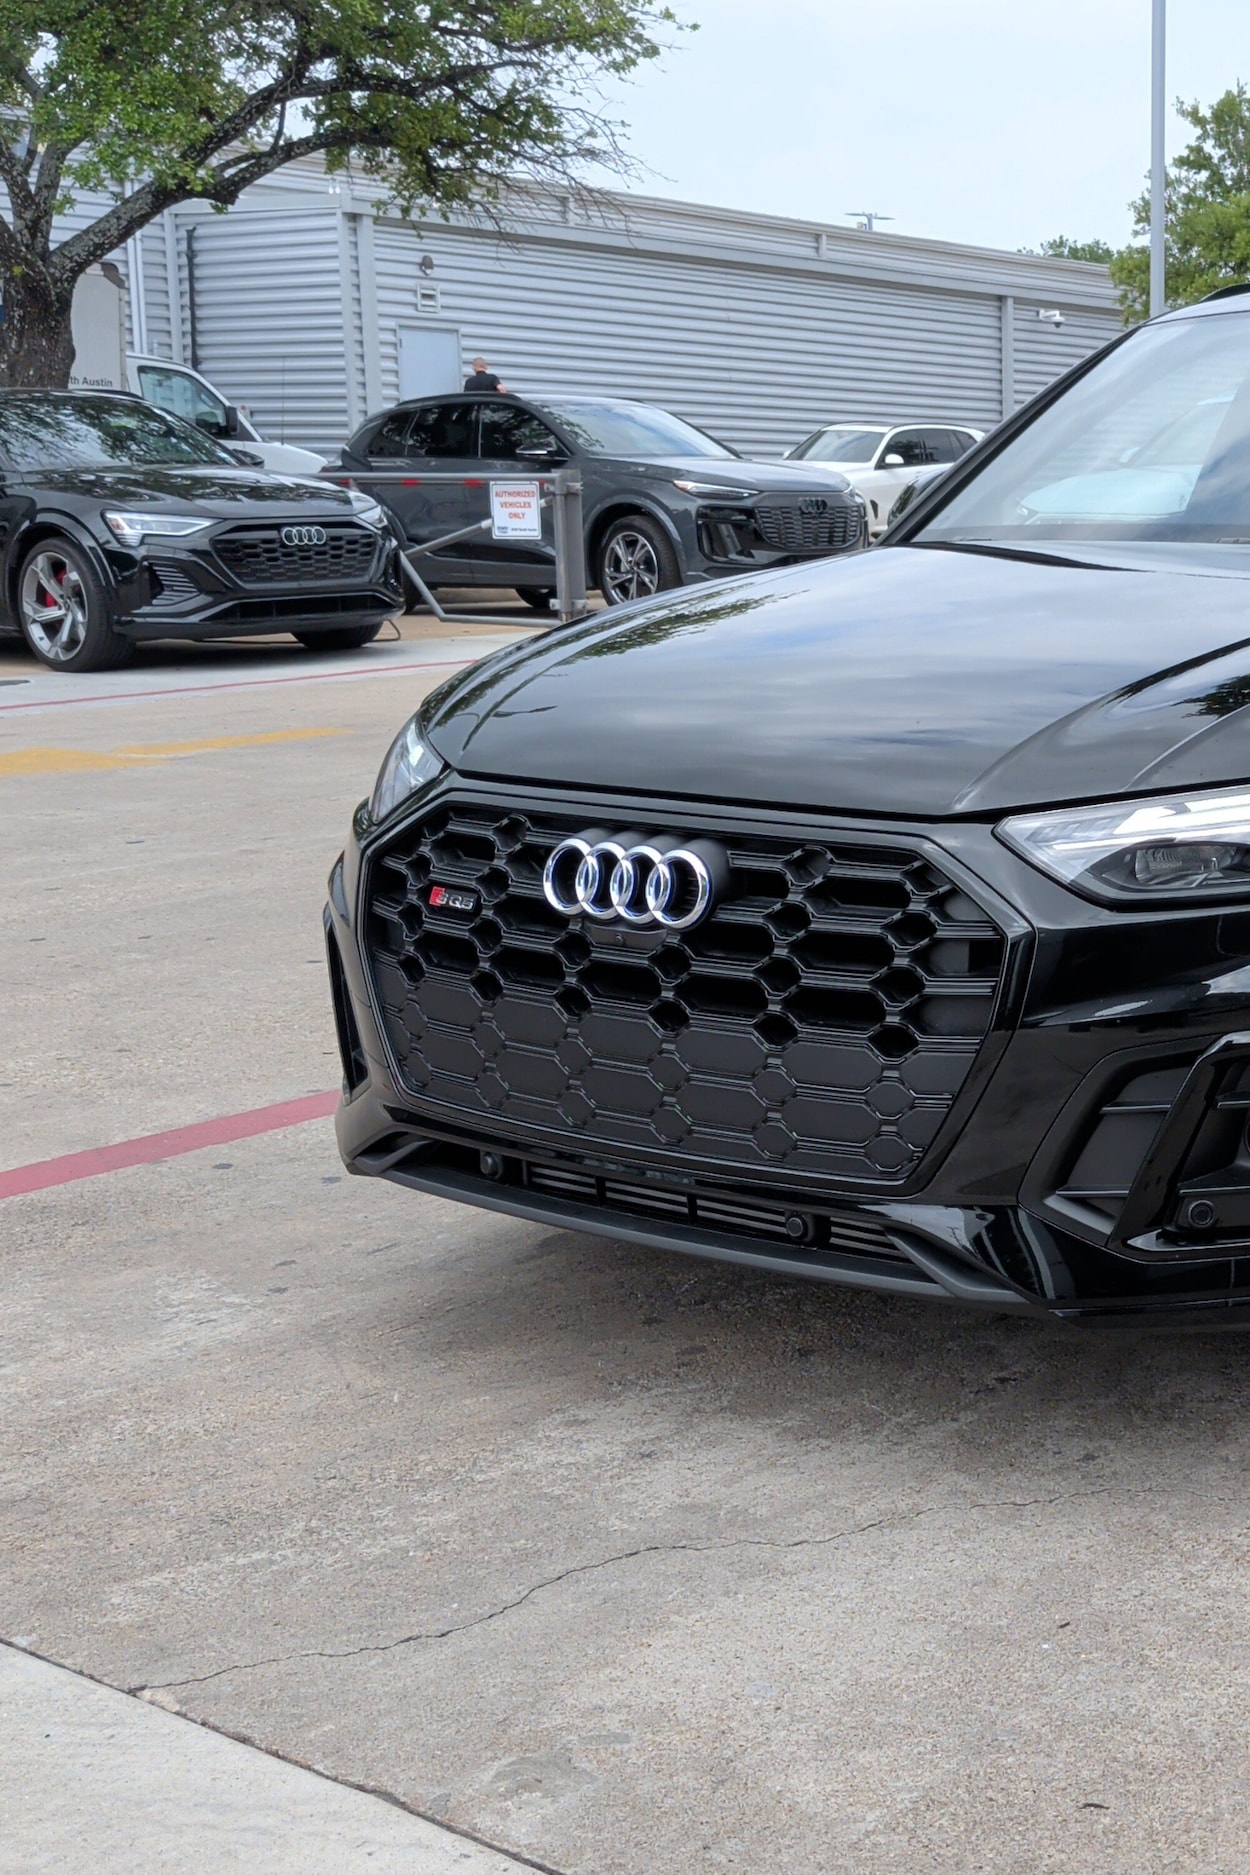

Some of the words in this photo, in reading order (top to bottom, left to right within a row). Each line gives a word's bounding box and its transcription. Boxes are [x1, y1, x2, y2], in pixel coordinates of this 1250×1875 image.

[82, 377, 113, 387] Austin
[495, 490, 536, 498] AUTHORIZED
[500, 501, 532, 509] VEHICLES
